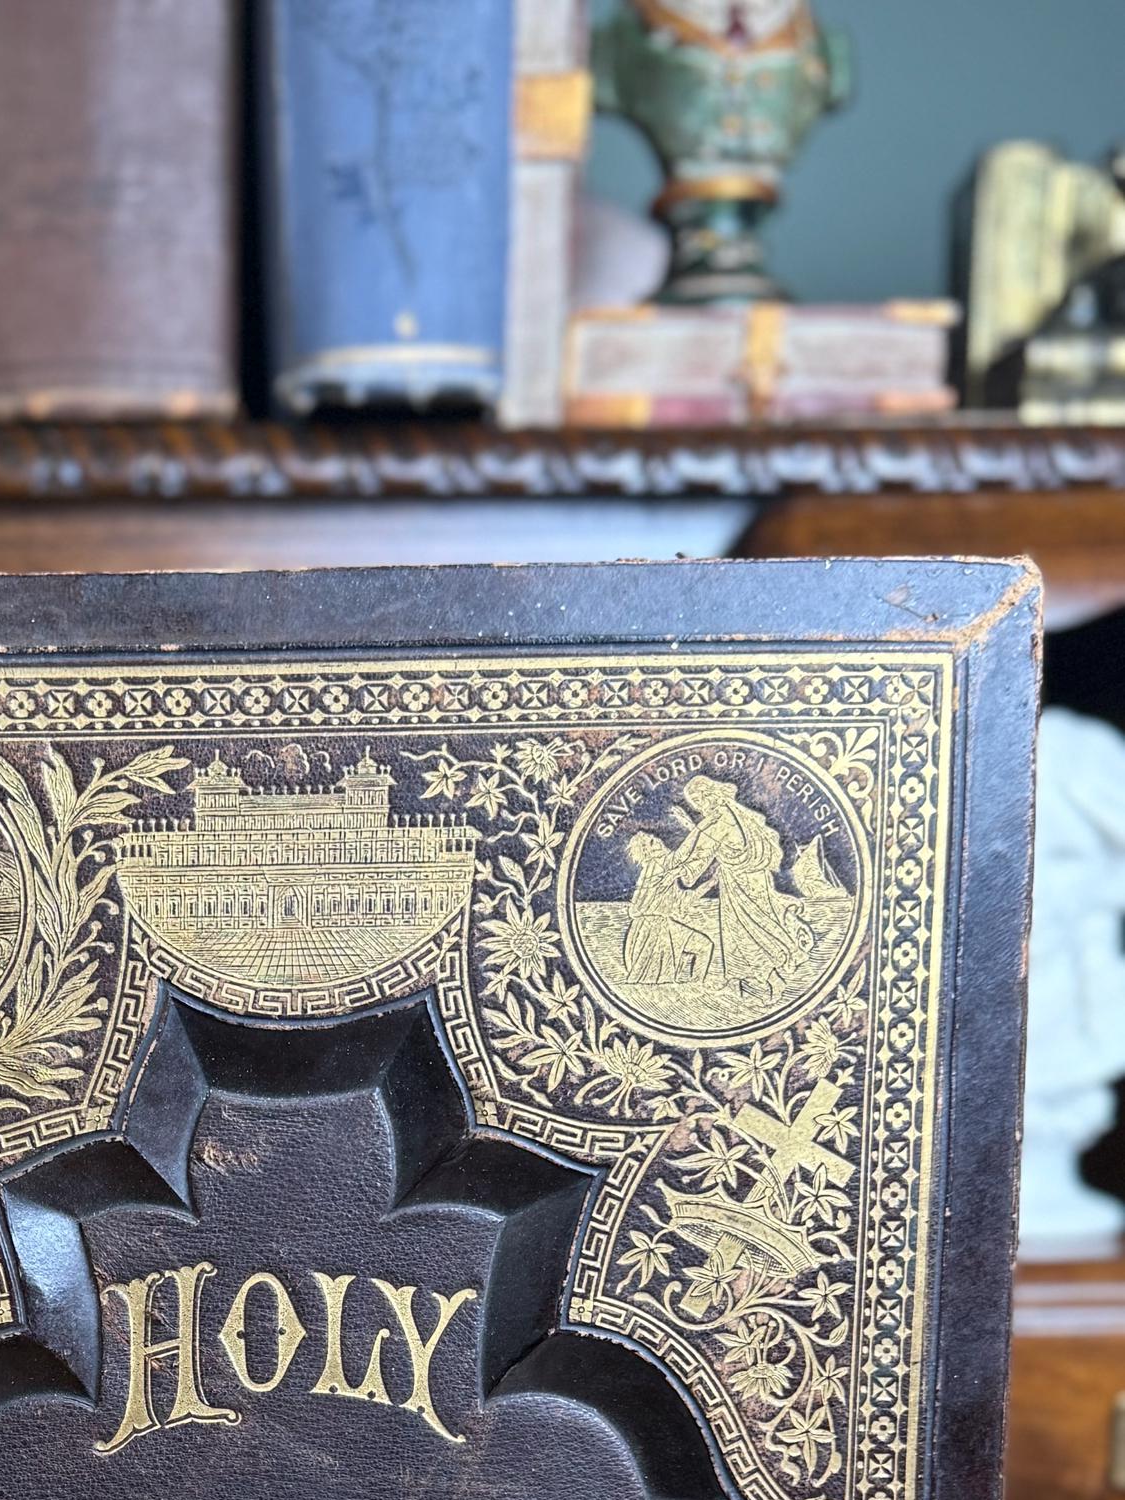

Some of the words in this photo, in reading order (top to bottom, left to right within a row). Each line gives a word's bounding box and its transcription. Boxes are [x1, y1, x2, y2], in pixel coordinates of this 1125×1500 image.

[596, 785, 644, 839] SAVE
[648, 753, 704, 791] LORD
[714, 750, 746, 769] OR
[757, 756, 765, 772] I
[774, 766, 841, 840] PERISH
[92, 1260, 478, 1457] HOLY
